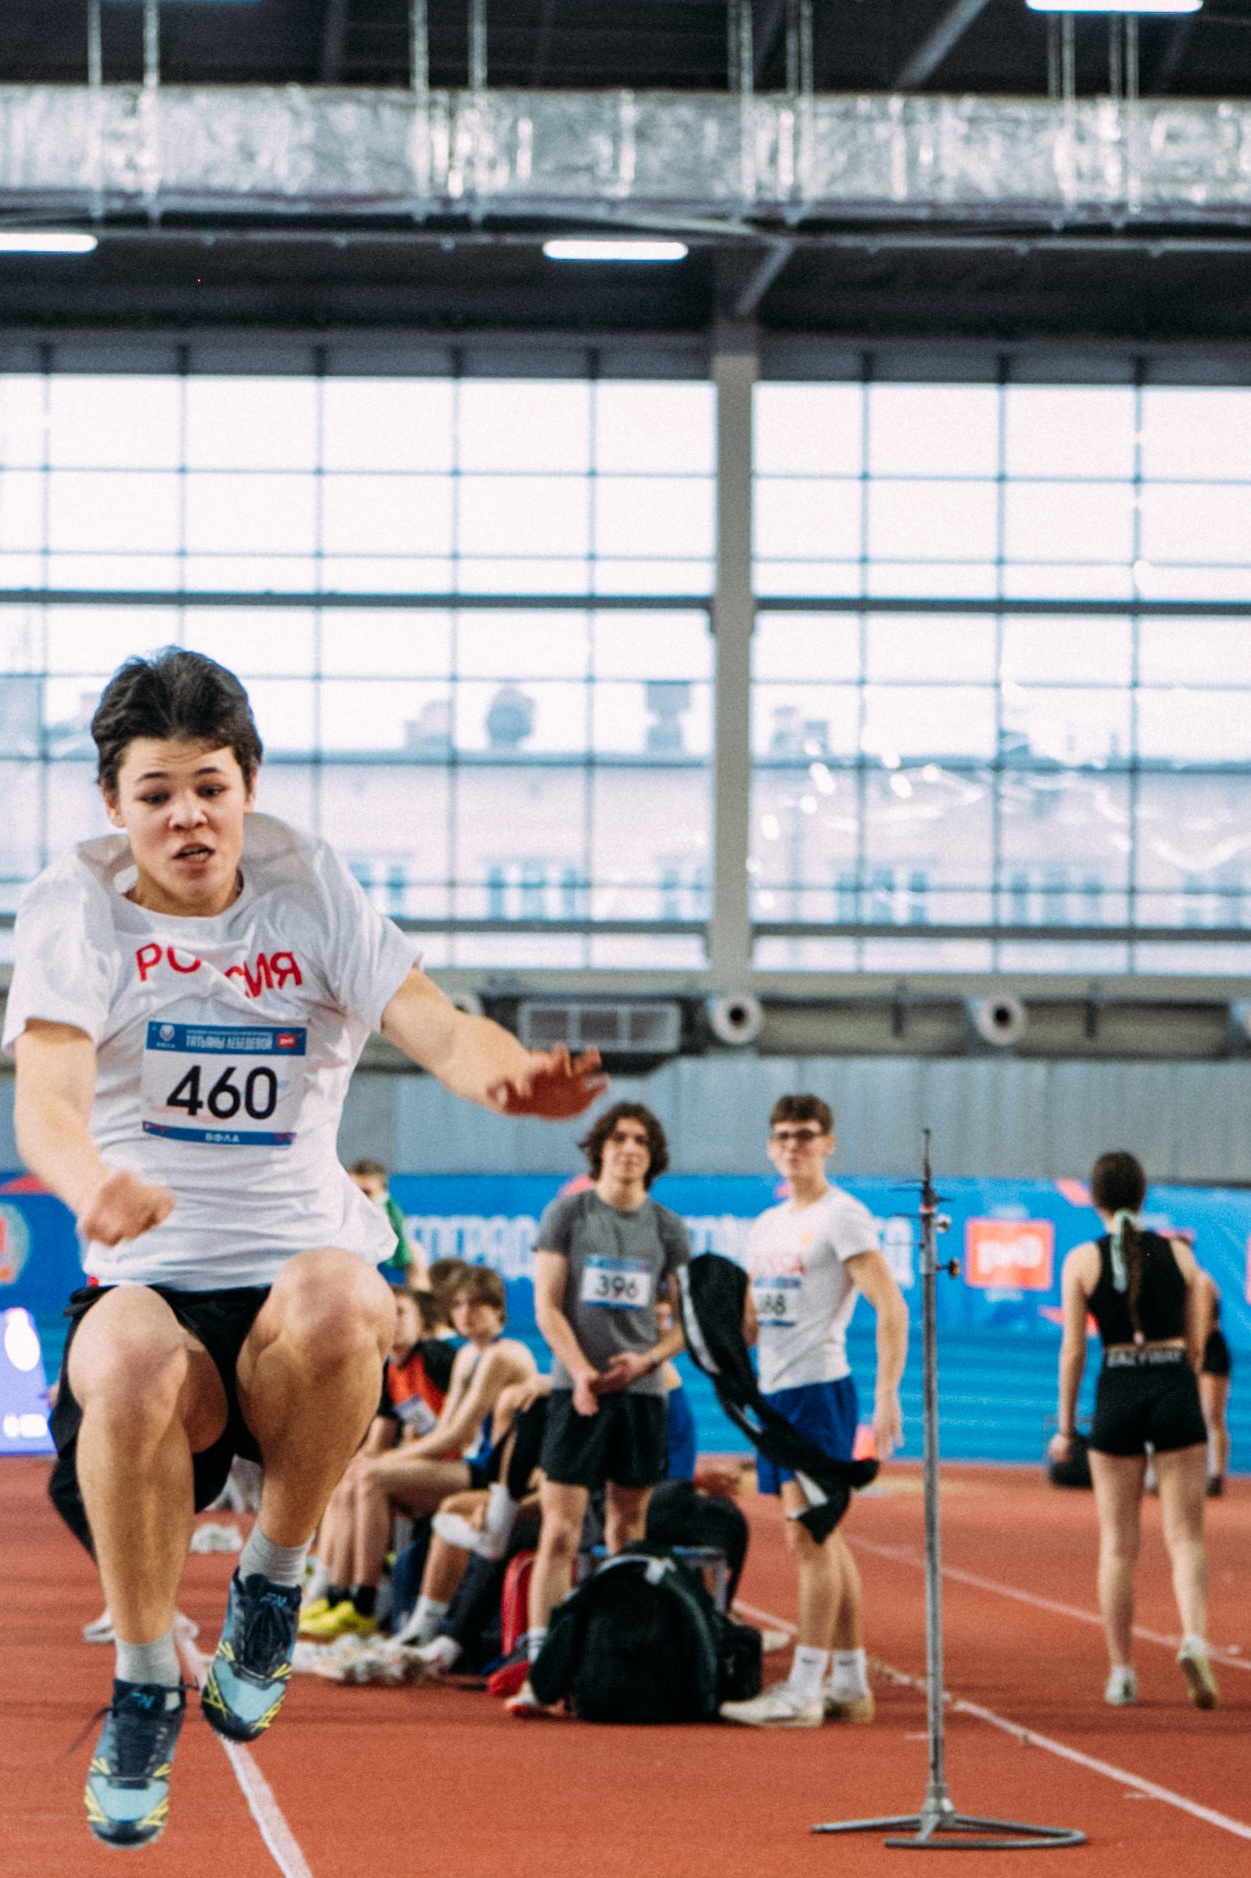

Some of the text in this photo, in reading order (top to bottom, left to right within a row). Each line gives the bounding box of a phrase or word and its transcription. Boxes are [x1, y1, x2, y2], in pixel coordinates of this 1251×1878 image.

[136, 943, 303, 998] РОИЯ
[166, 1065, 277, 1120] 460
[594, 1275, 640, 1299] 396
